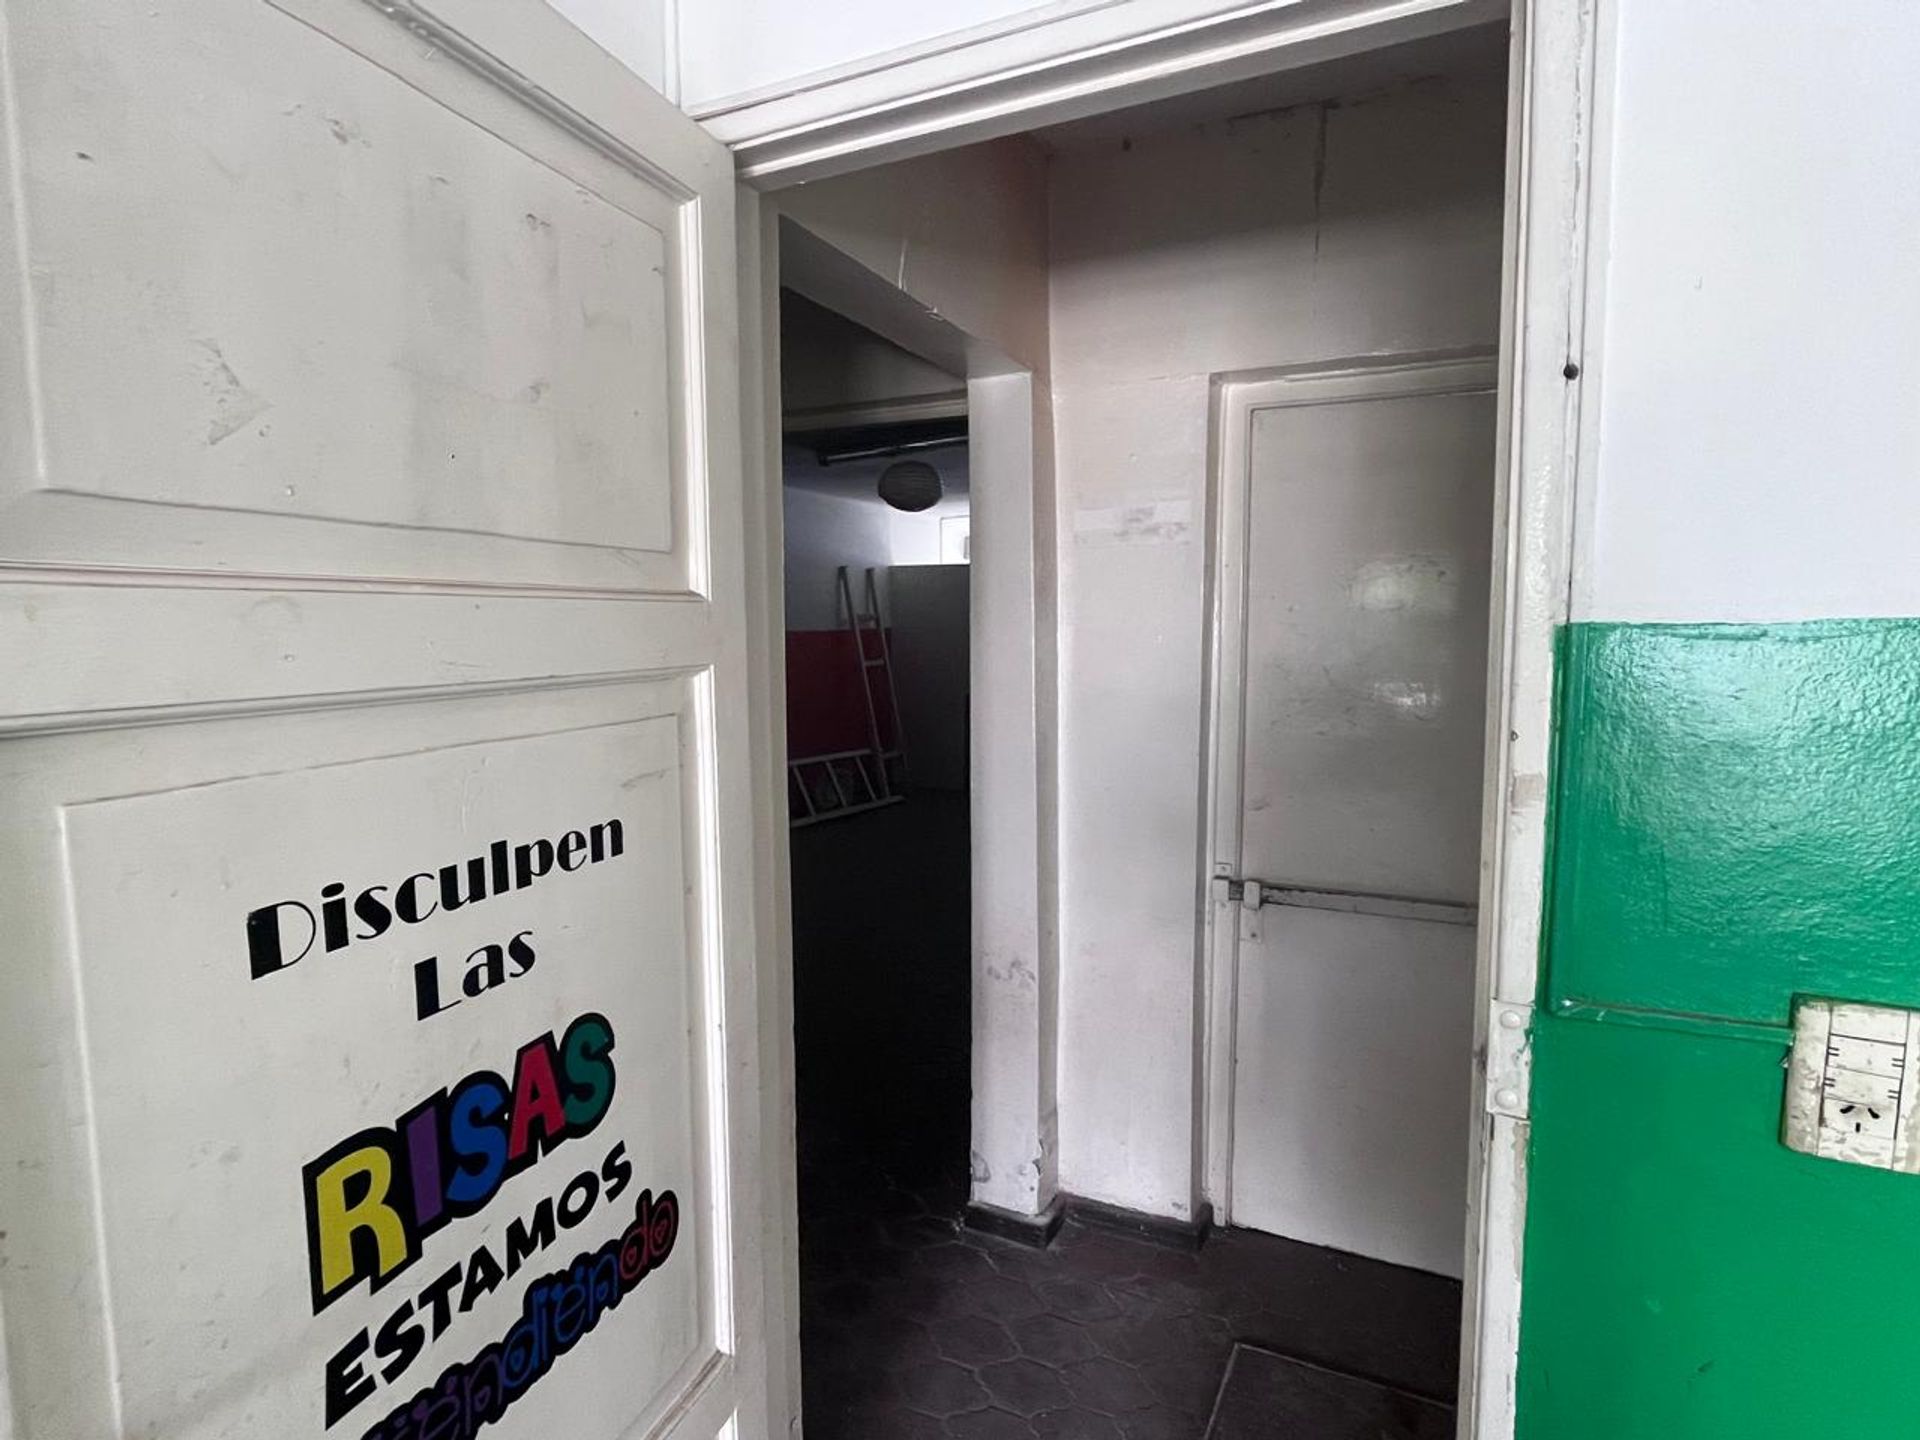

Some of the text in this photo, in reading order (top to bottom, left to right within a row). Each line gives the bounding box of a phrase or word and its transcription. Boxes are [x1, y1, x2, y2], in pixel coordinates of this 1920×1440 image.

[246, 818, 624, 981] Disculpen
[413, 930, 536, 1022] Las
[301, 1012, 616, 1317] RISAS
[325, 1140, 633, 1431] ESTAMOS
[361, 1188, 679, 1440] endiendo
